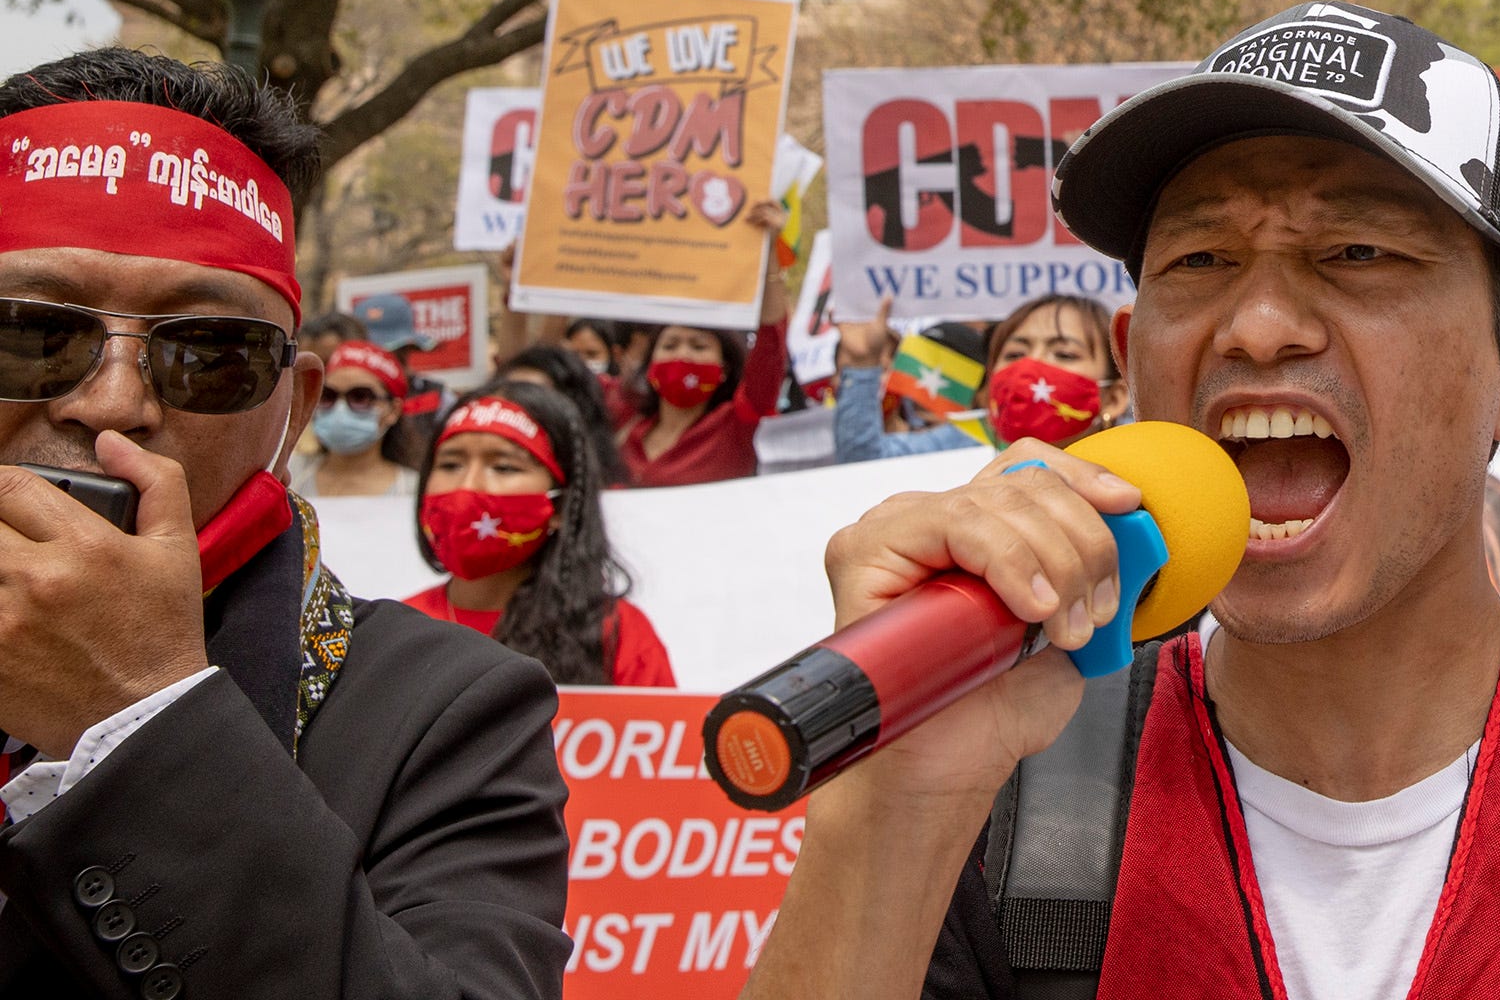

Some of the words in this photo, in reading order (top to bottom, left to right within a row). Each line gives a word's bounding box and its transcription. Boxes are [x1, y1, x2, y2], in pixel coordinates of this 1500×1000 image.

[602, 31, 654, 81] WE
[666, 22, 738, 73] LOVE
[1220, 41, 1364, 79] ORIGINAL
[1239, 29, 1358, 54] TAYLORMADE
[1325, 70, 1346, 84] 79
[573, 83, 746, 169] CDM
[862, 97, 1137, 253] CD
[865, 264, 942, 299] WE
[954, 260, 1137, 299] SUPPO
[569, 817, 805, 880] BODIES
